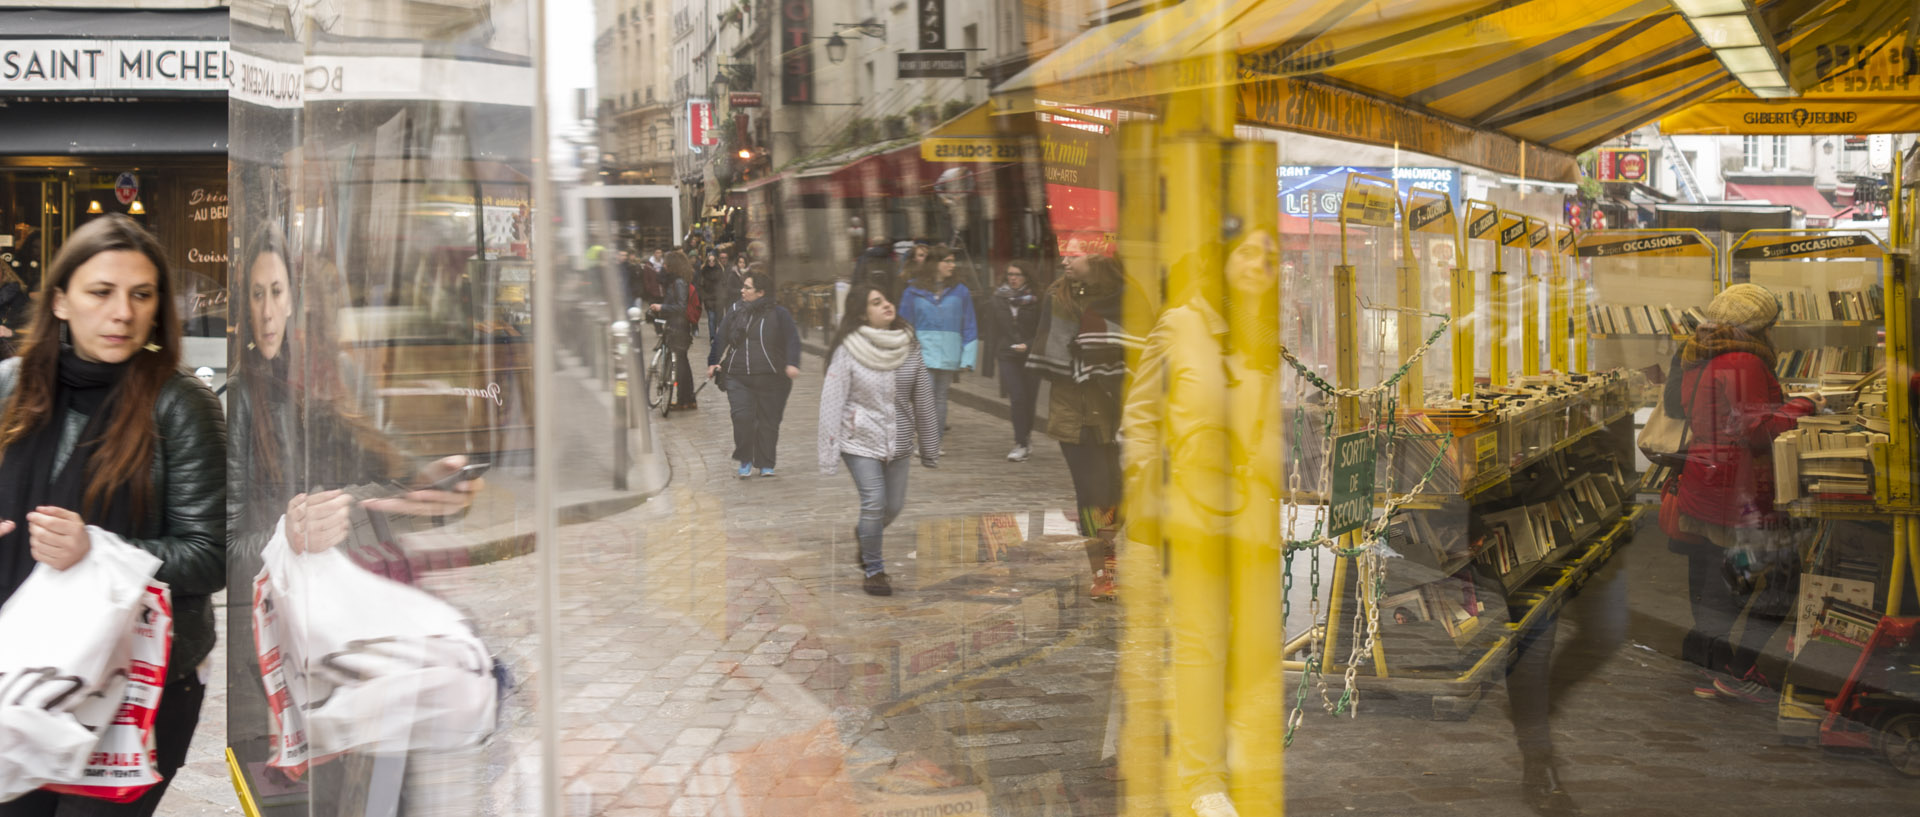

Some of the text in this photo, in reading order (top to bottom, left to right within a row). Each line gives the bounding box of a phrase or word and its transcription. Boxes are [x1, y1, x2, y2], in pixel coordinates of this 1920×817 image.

[4, 49, 231, 81] SAINT MICHEL
[1058, 139, 1089, 167] mini
[1286, 193, 1317, 214] LE
[194, 209, 207, 221] AU
[1597, 235, 1683, 256] Super OCCASIONS
[1763, 236, 1855, 257] Super OCCASIONS
[1350, 473, 1359, 493] DE
